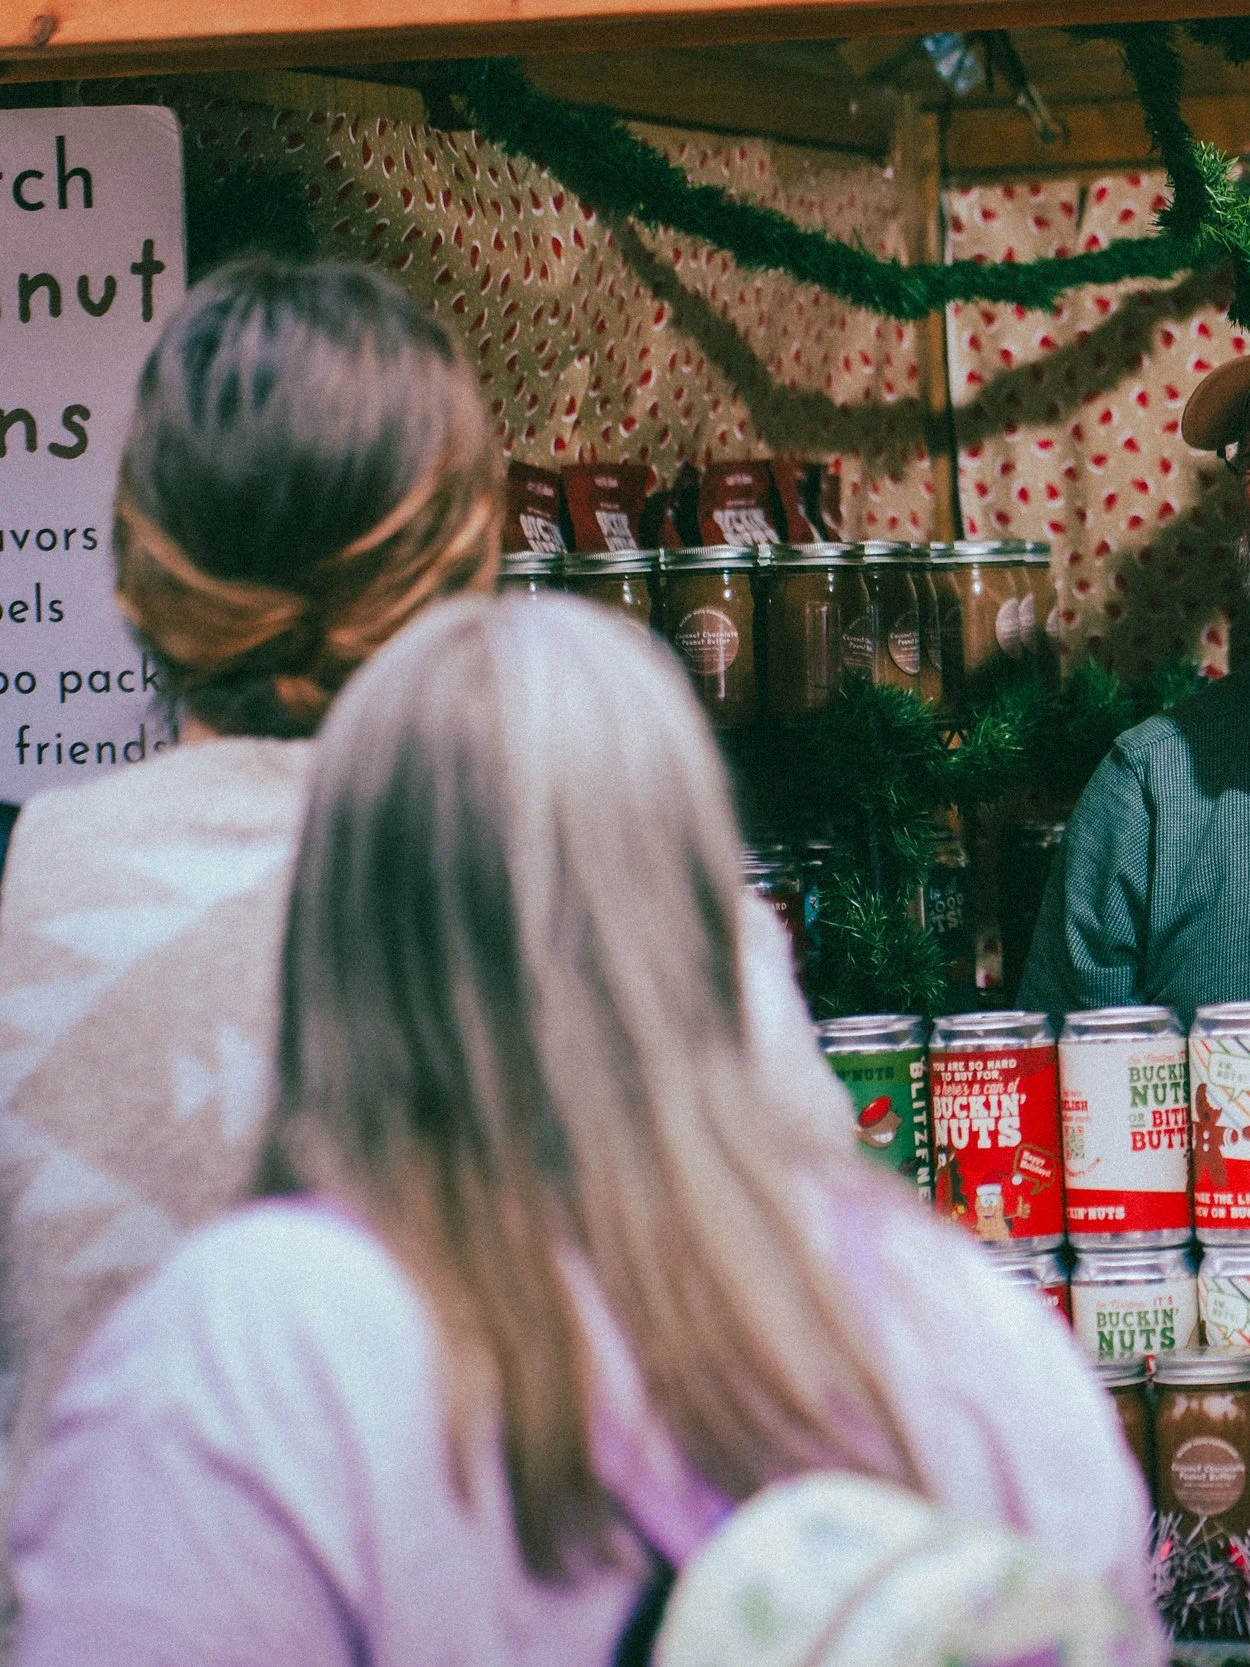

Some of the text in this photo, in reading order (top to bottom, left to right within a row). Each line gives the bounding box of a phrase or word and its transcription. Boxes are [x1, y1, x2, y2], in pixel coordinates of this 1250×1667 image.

[0, 135, 94, 211] ch
[15, 238, 167, 324] nut
[0, 526, 98, 552] vors
[58, 651, 162, 704] pack
[968, 1060, 985, 1071] SO
[986, 1058, 1018, 1070] HARD
[932, 1094, 1028, 1119] BUCKIN'
[934, 1116, 1023, 1150] NUTS
[1213, 1193, 1235, 1205] THE
[1211, 1206, 1227, 1219] ON
[1096, 1308, 1179, 1328] BUCKIN'
[1097, 1326, 1177, 1351] NUTS
